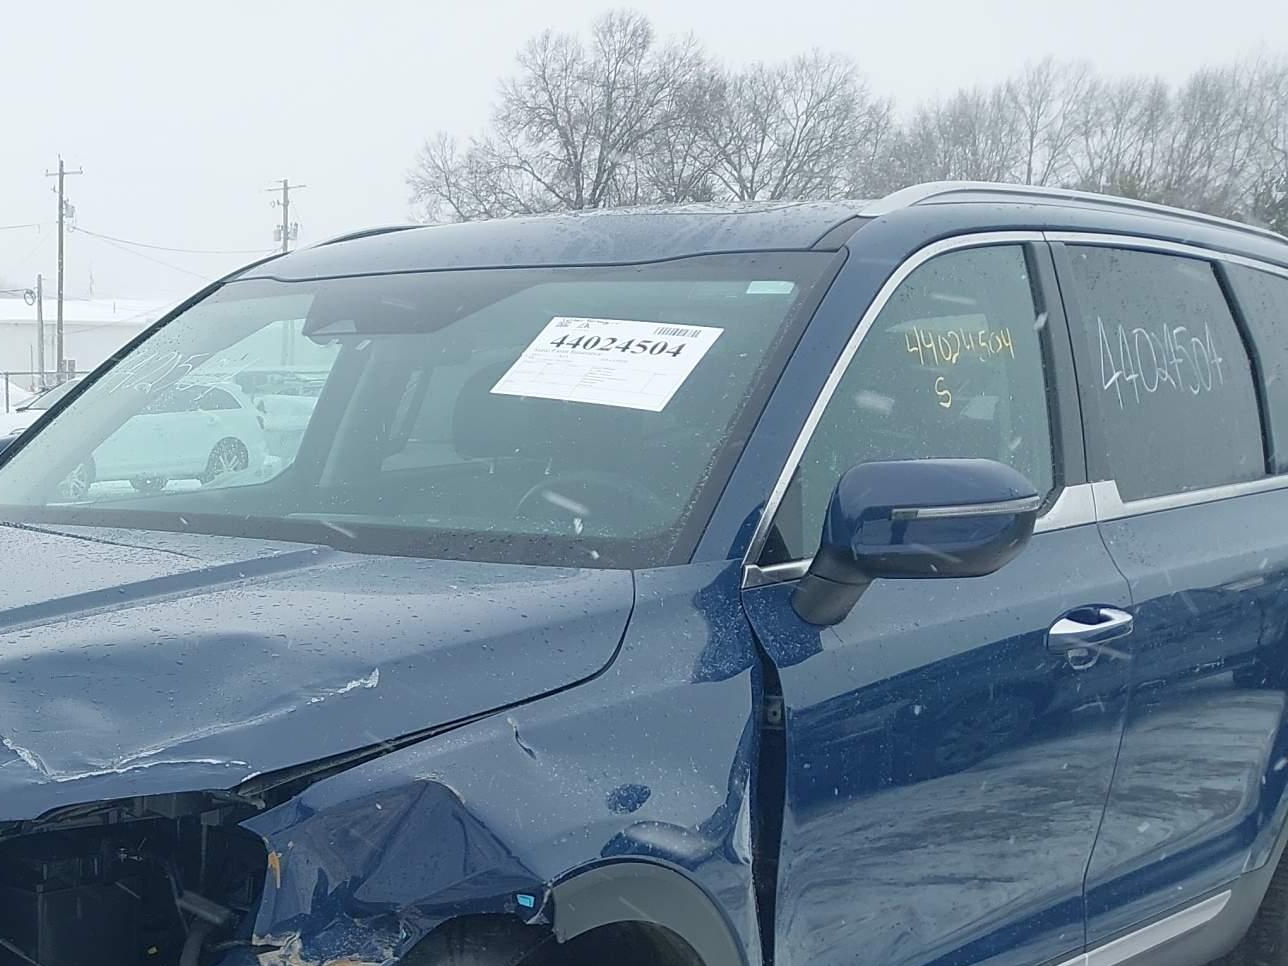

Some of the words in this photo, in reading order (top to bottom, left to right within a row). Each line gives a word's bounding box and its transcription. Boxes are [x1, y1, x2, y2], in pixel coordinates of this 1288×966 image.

[550, 333, 687, 358] 44024504
[904, 325, 1015, 366] 44024504
[1097, 316, 1224, 410] 44024504
